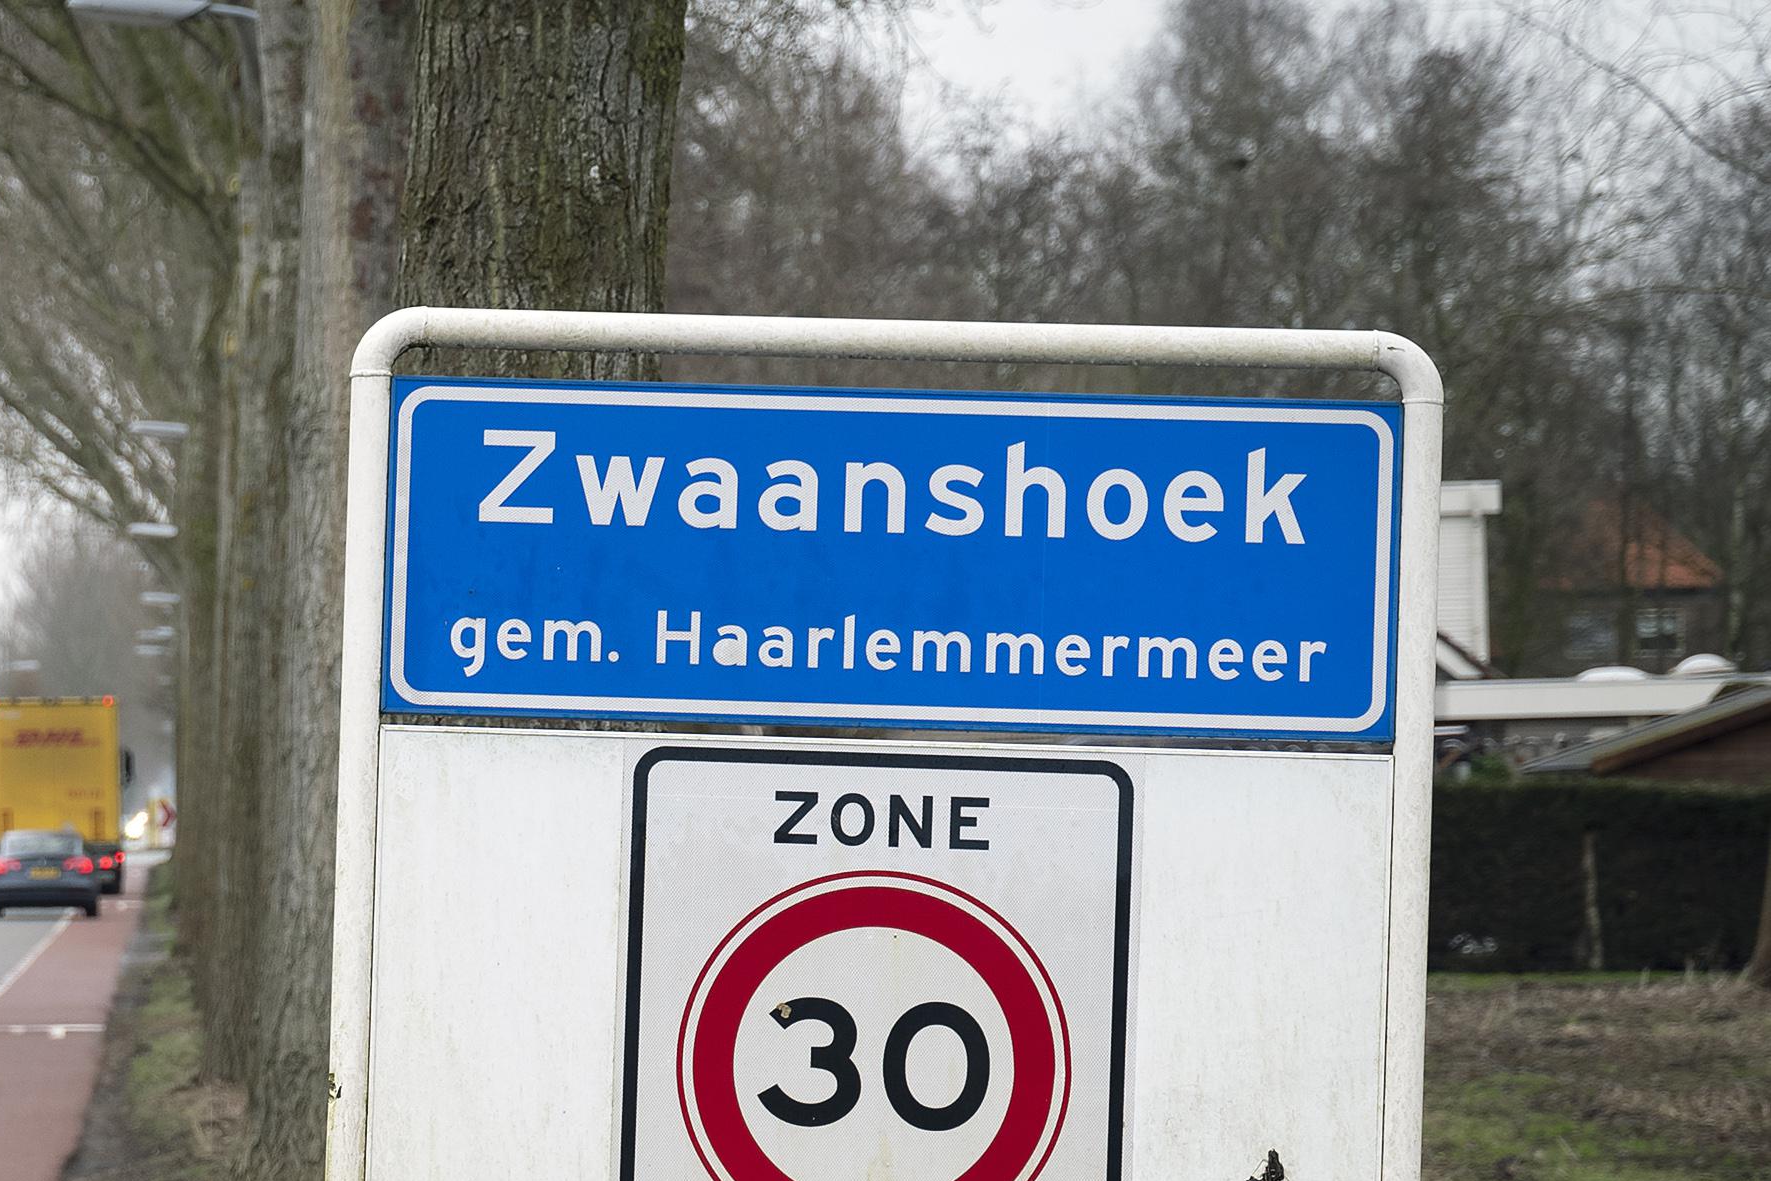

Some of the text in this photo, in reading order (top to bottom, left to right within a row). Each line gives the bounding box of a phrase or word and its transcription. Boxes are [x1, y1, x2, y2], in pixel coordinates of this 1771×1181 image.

[478, 429, 1307, 545] Zwaanshoek
[450, 610, 1327, 683] gem. Haarlemmermeer
[773, 790, 991, 851] ZONE
[756, 996, 991, 1132] 30
